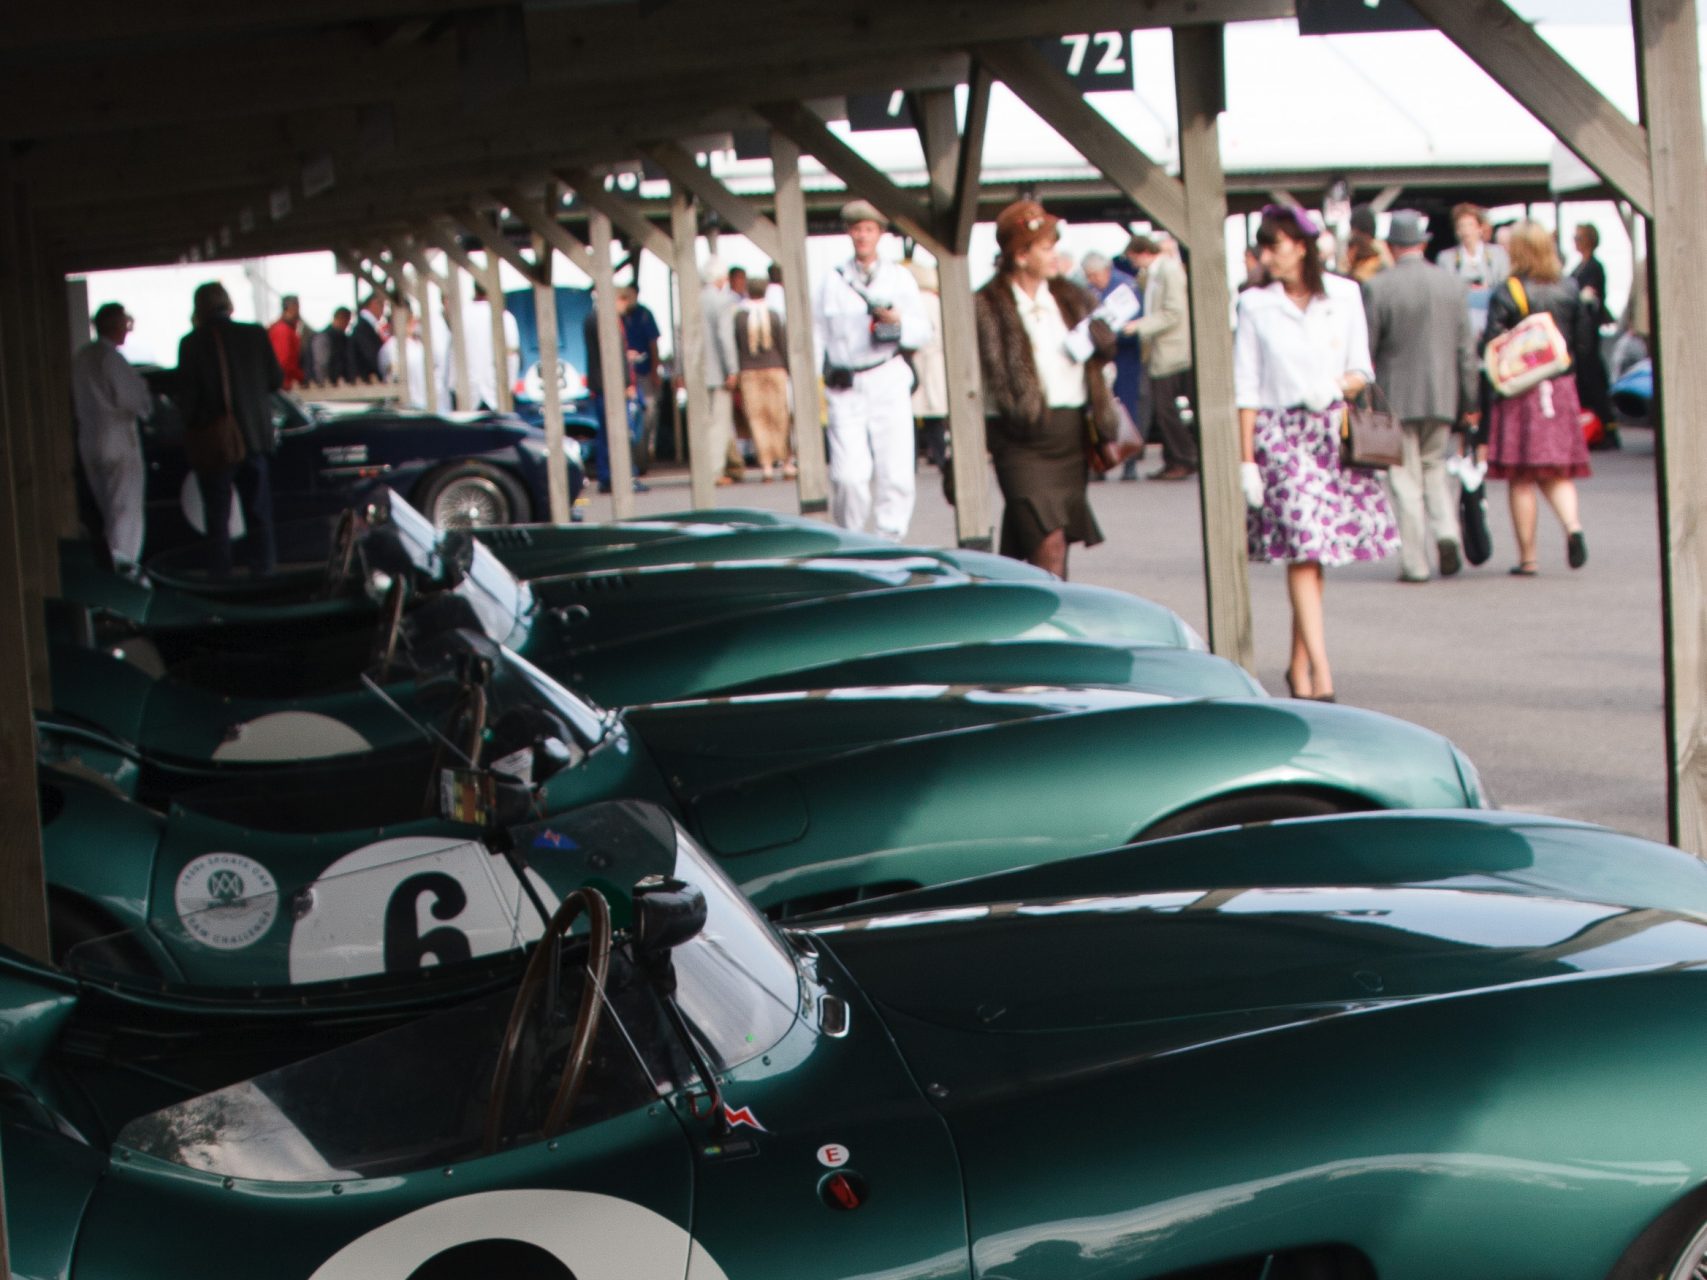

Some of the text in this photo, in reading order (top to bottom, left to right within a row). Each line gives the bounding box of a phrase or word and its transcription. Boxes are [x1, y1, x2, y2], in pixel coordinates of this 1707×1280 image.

[1061, 31, 1126, 76] 72
[383, 871, 473, 973] 6
[824, 1147, 841, 1163] E
